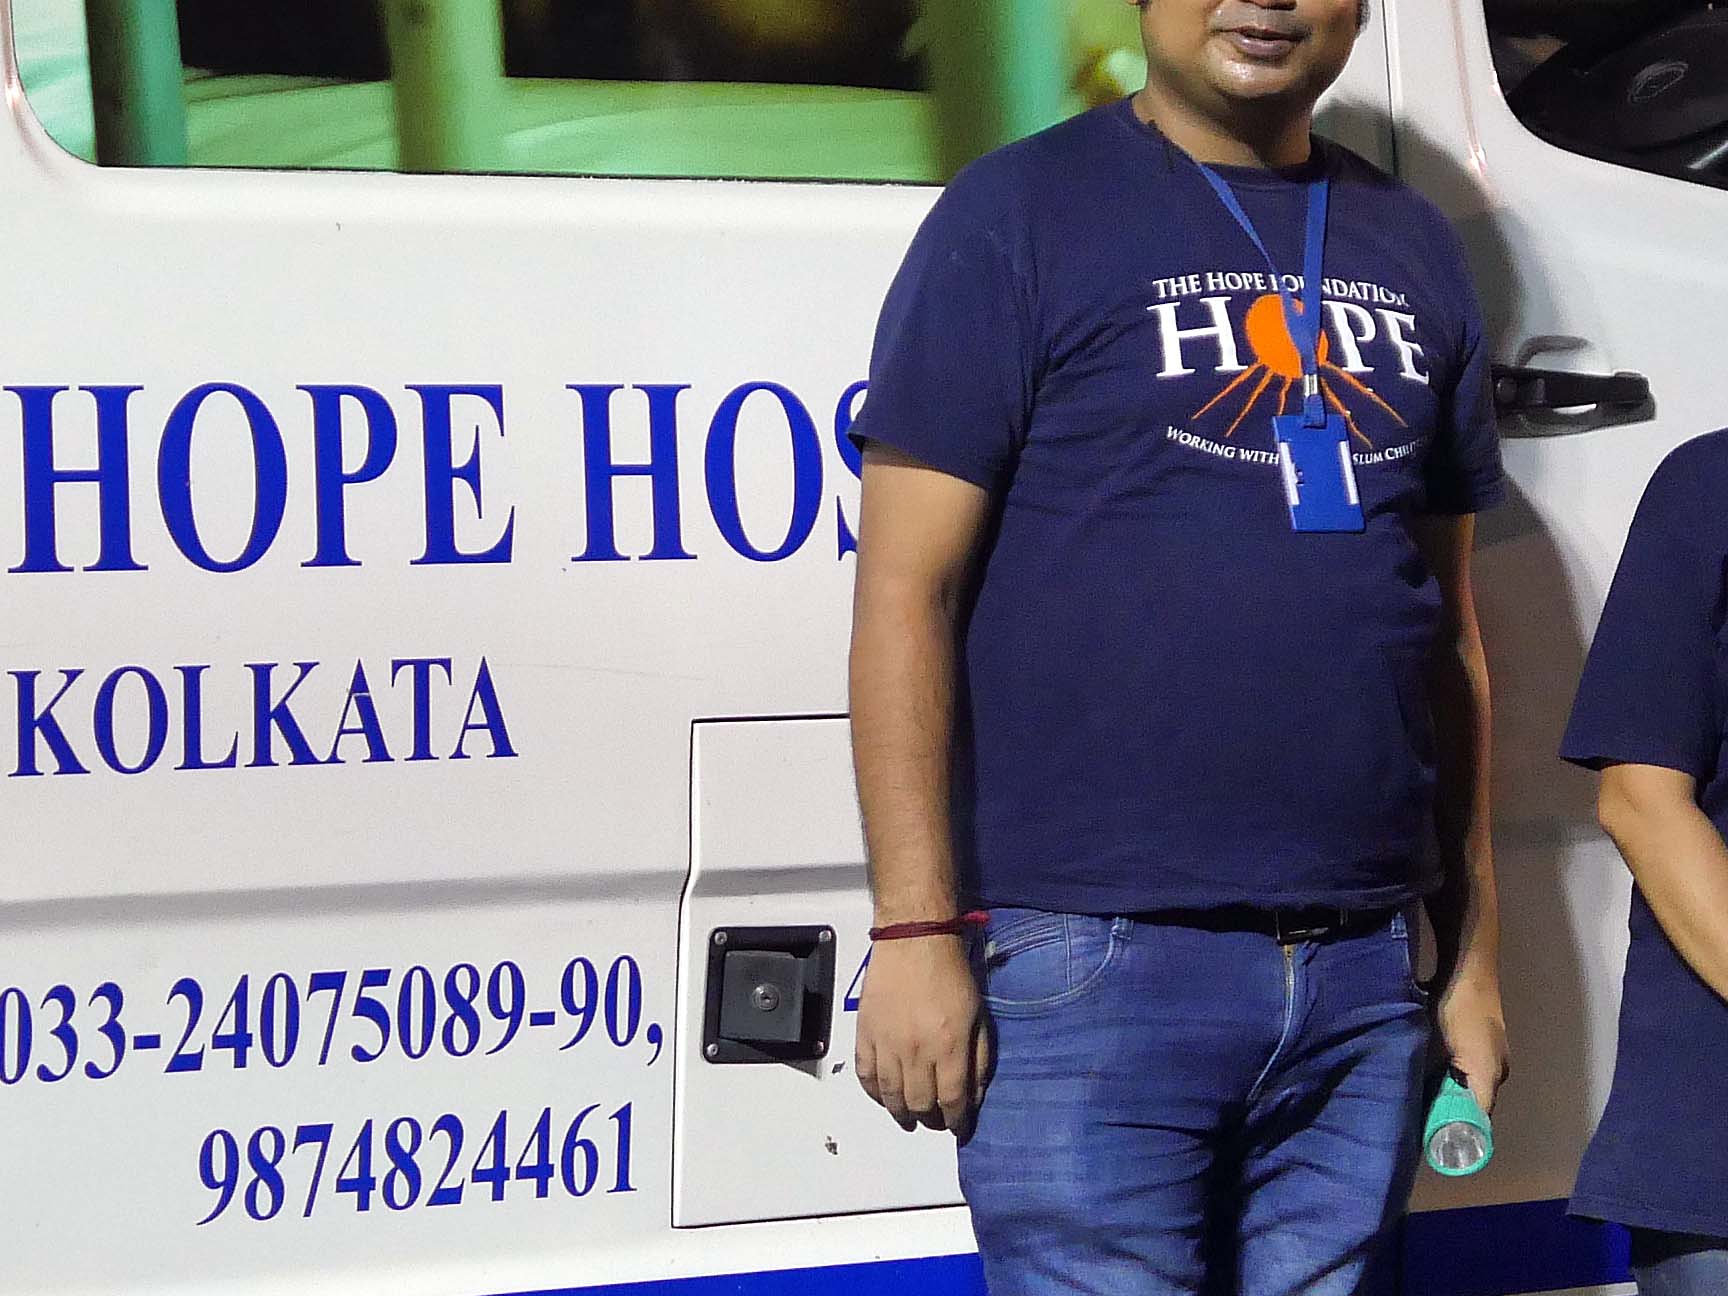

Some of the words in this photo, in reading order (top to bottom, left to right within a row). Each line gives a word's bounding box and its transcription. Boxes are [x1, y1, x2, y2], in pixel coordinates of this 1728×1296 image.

[1152, 273, 1202, 298] THE
[1205, 271, 1267, 292] HOPE
[3, 381, 516, 574] HOPE
[1165, 424, 1236, 459] WORKING
[1238, 447, 1279, 466] WITH
[1352, 451, 1384, 465] SLUM
[5, 655, 520, 778] KOLKATA
[197, 1101, 639, 1226] 9874824461
